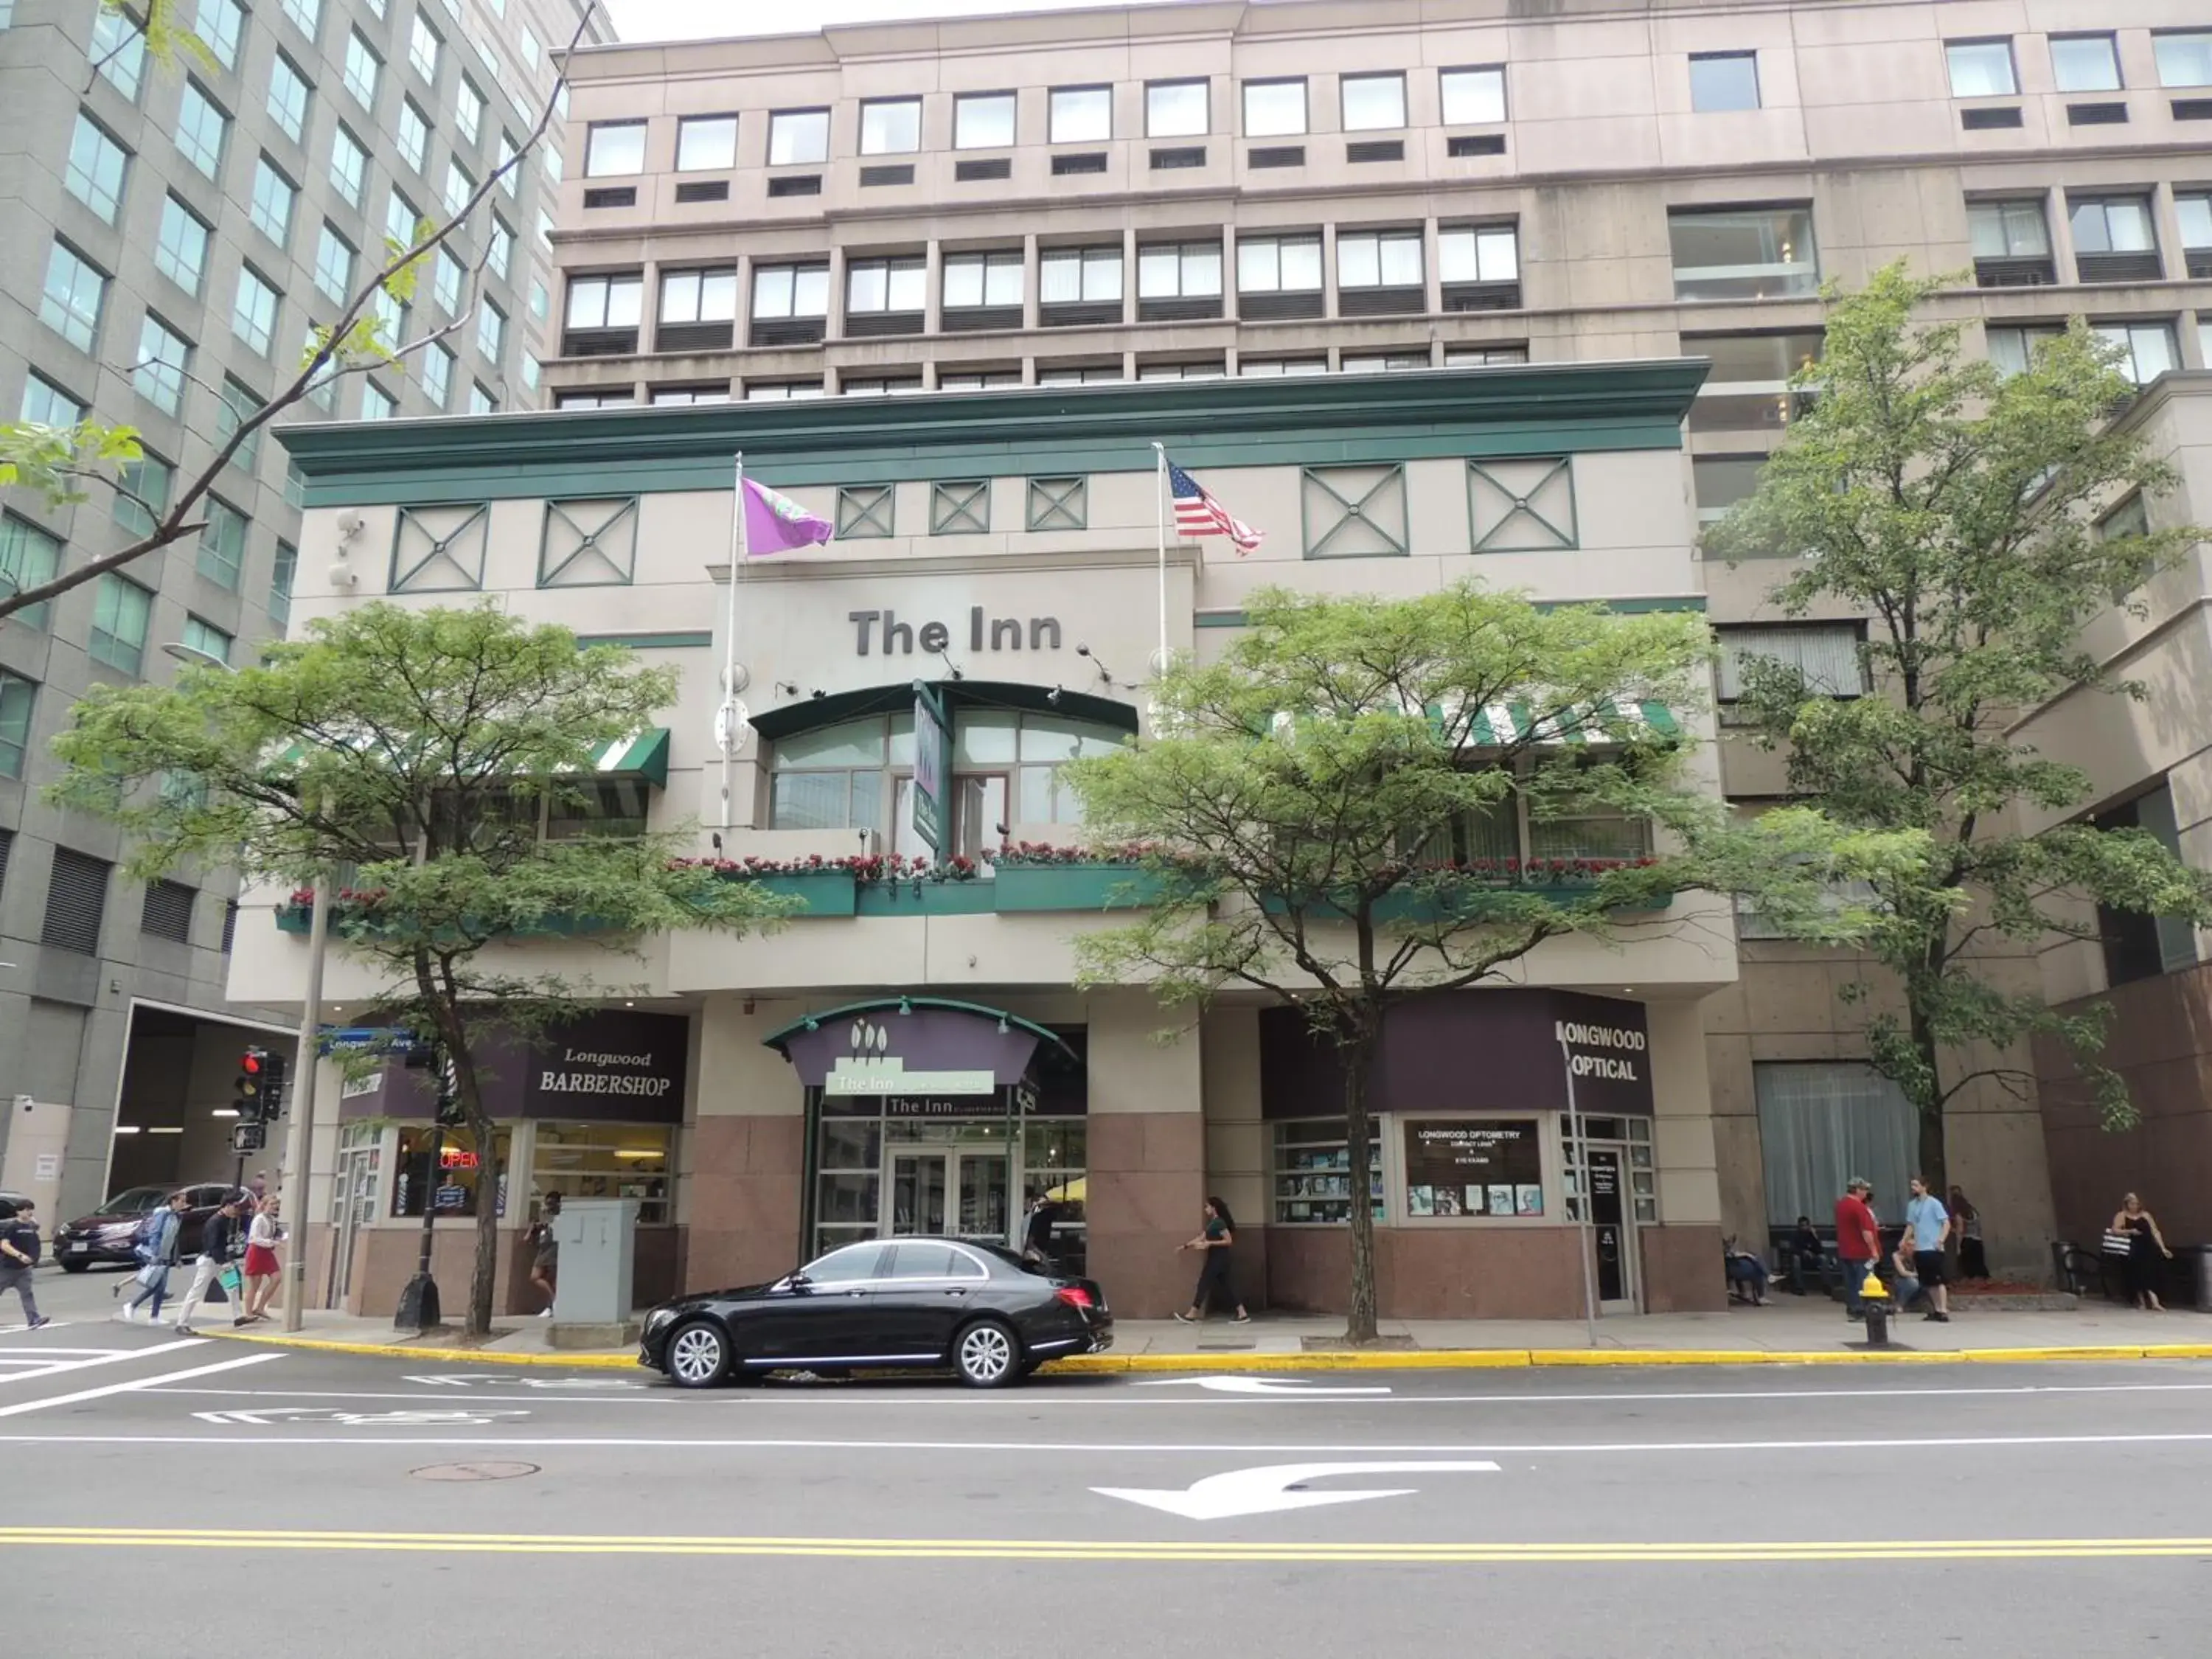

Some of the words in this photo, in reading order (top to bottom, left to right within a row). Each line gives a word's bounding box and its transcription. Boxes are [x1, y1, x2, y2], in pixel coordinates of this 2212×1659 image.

[849, 609, 949, 655] The
[970, 605, 1060, 652] Inn
[1556, 1020, 1645, 1051] LONGWOOD
[564, 1048, 652, 1067] Longwood
[1571, 1054, 1638, 1081] OPTICAL
[540, 1071, 670, 1096] BARBERSHOP
[838, 1077, 867, 1091] The
[870, 1077, 894, 1091] Inn
[890, 1098, 919, 1113] The
[925, 1099, 953, 1113] Inn
[1418, 1130, 1468, 1139] LONGWOOD
[1470, 1130, 1522, 1139] OPTOMETRY
[439, 1152, 482, 1169] OPEN
